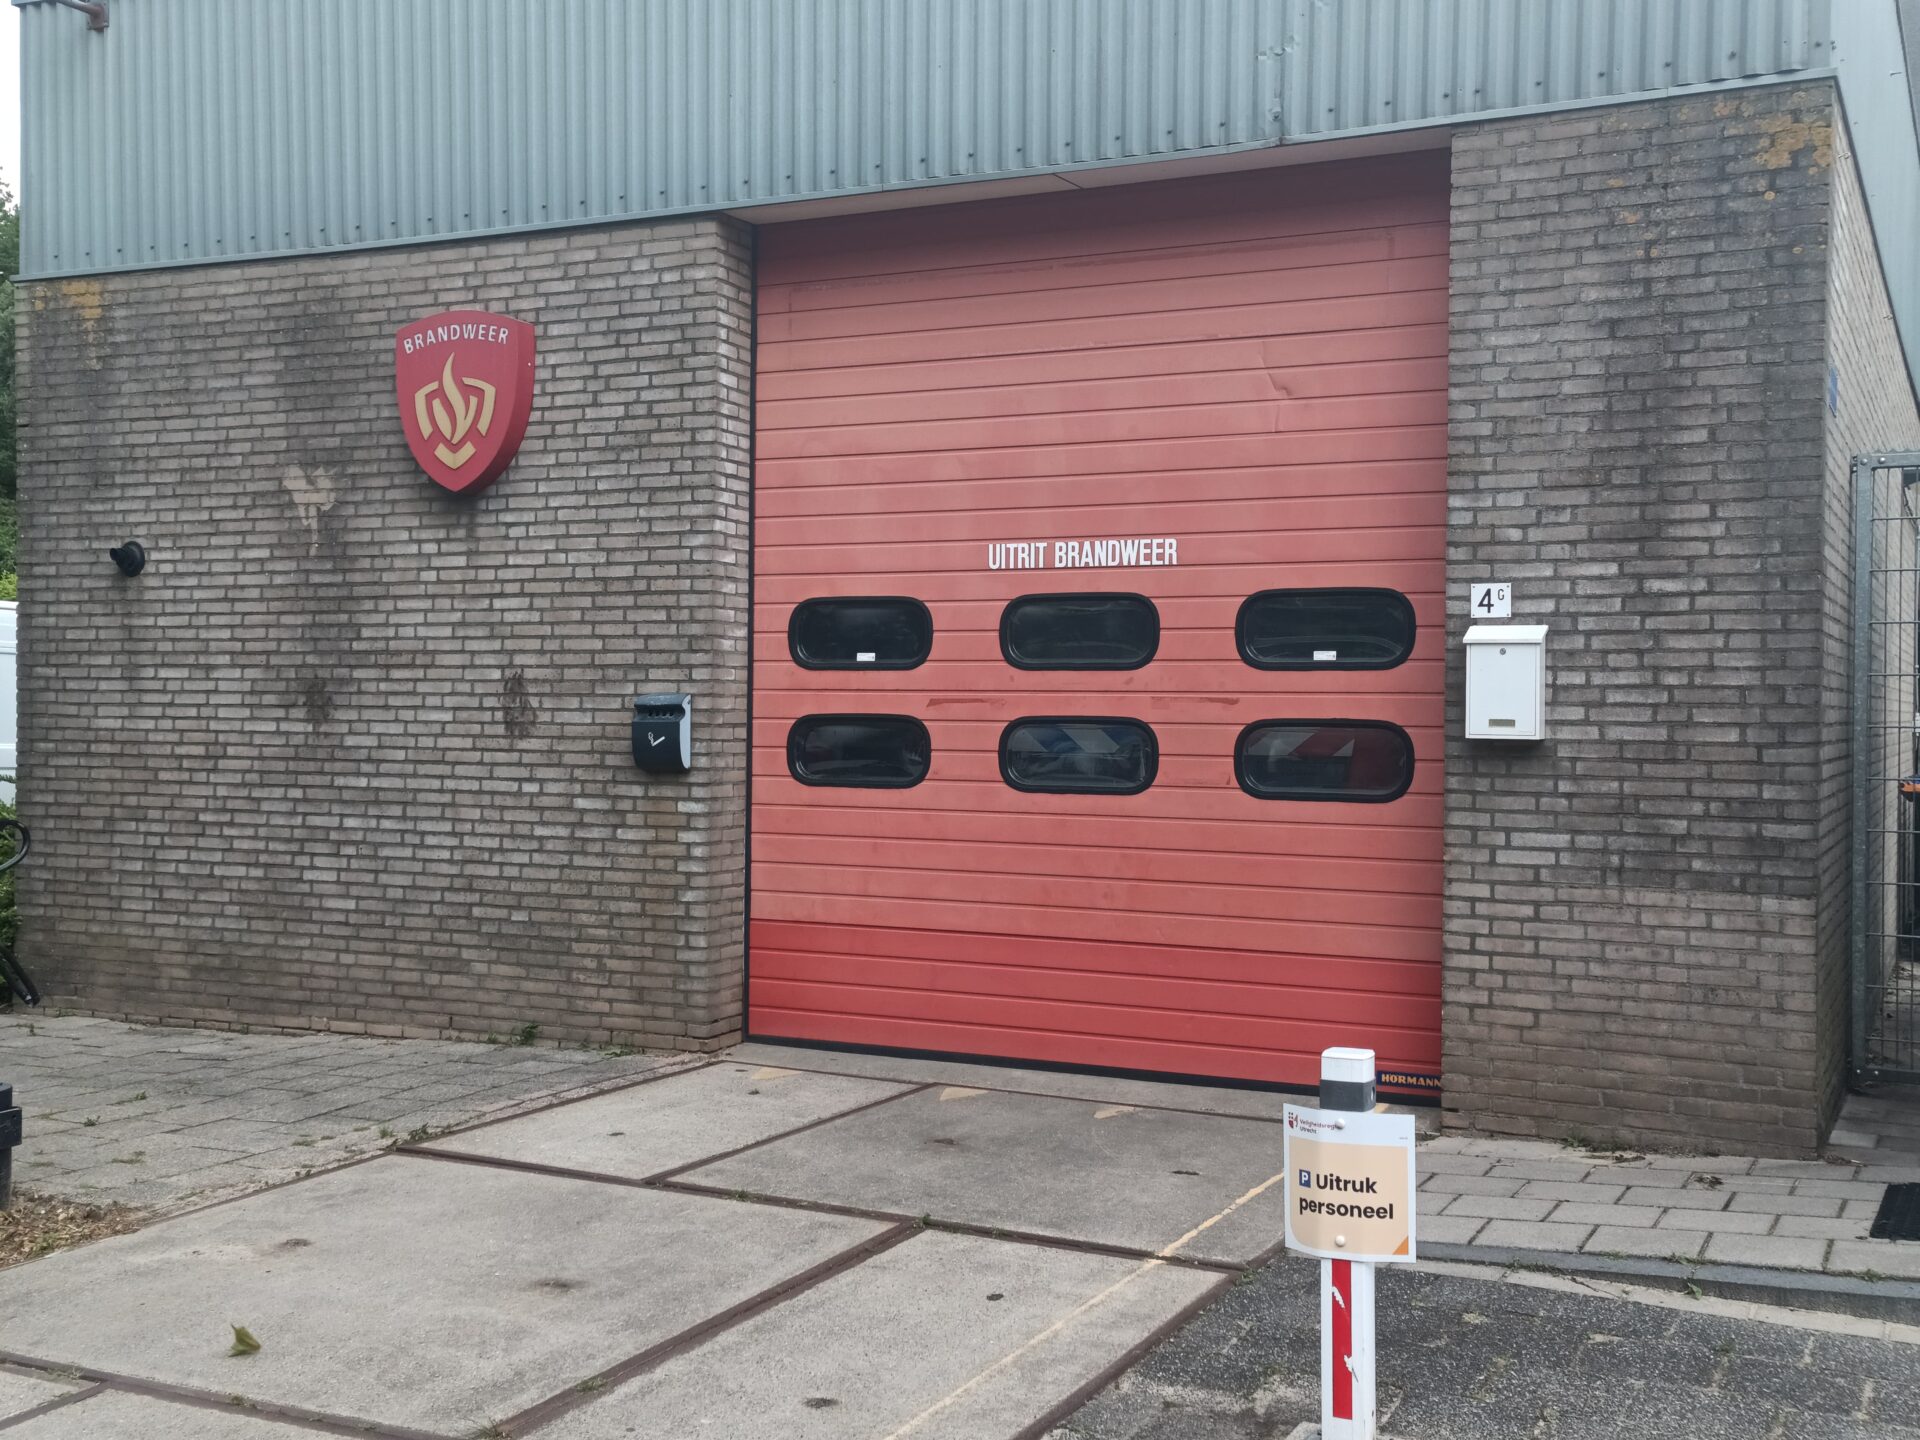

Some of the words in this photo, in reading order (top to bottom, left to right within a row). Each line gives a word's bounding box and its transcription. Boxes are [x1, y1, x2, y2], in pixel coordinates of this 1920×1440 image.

[403, 323, 509, 355] BRANDWEER
[988, 542, 1048, 570] UITRIT
[1054, 538, 1178, 569] BRANDWEER
[1301, 1171, 1310, 1185] P
[1315, 1173, 1378, 1194] Uitruk
[1299, 1197, 1394, 1220] personeel
